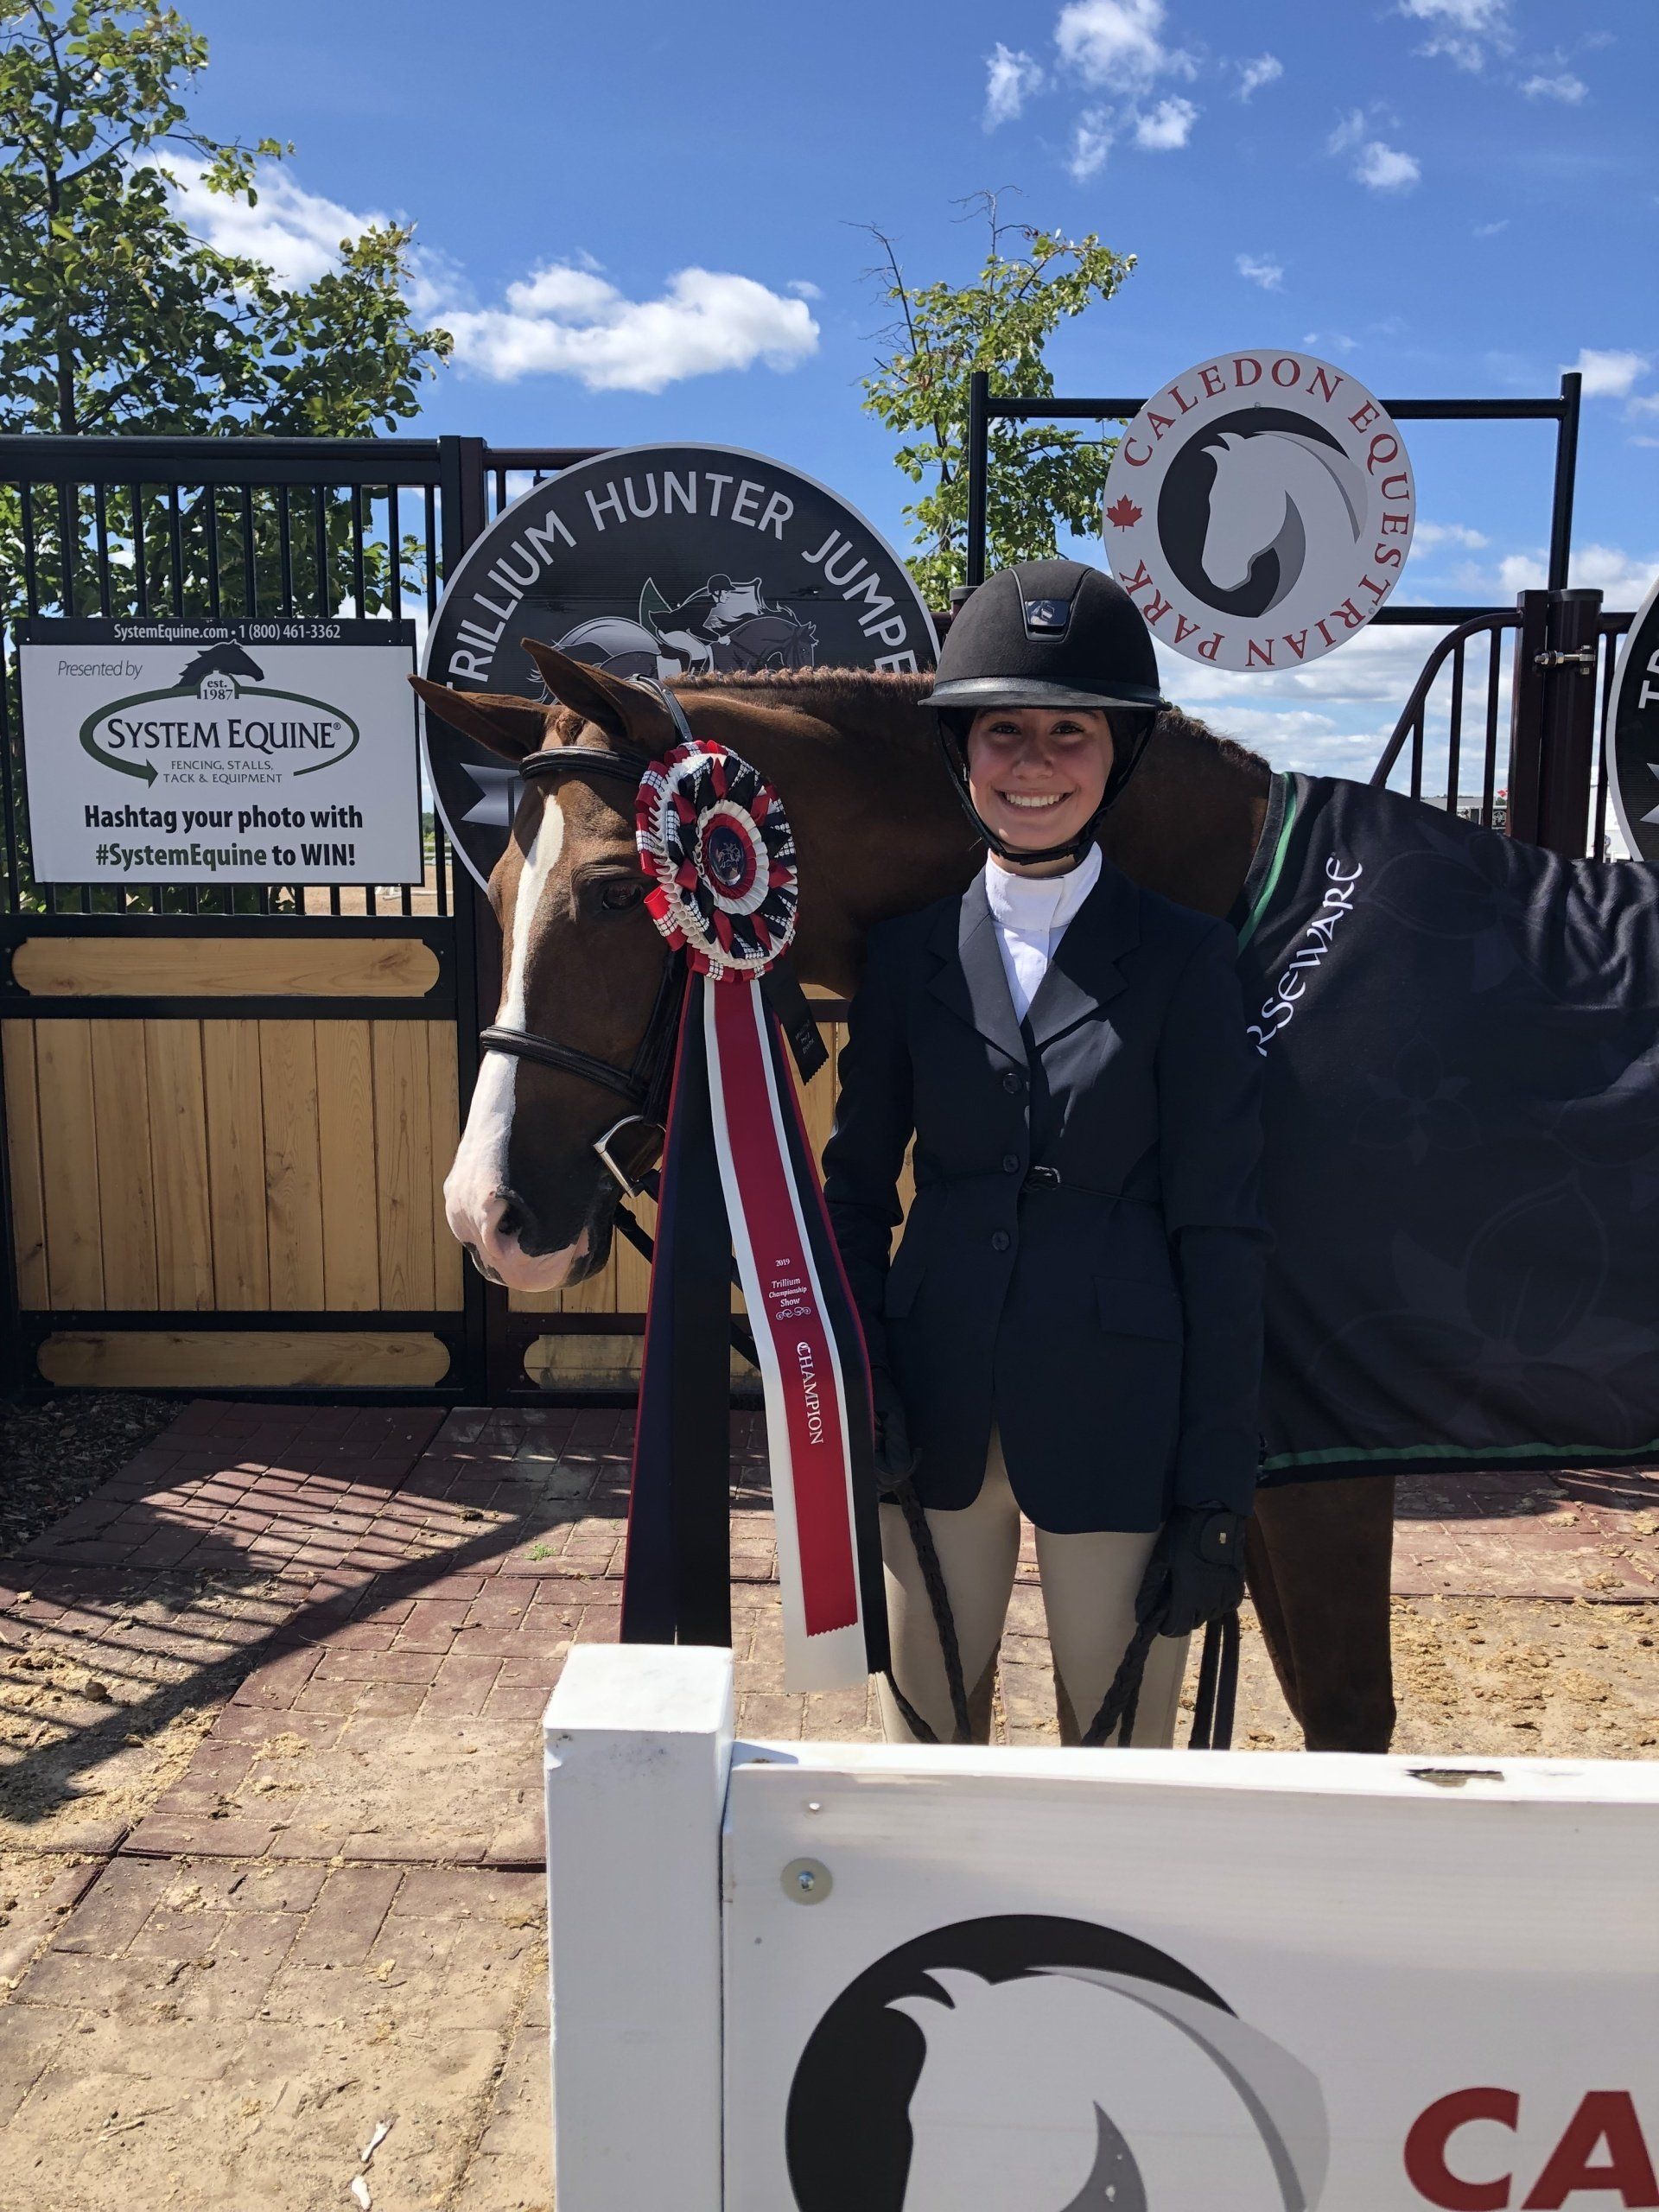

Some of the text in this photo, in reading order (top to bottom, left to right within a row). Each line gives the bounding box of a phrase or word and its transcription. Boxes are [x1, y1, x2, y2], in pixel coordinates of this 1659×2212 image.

[1119, 358, 1410, 667] CALEDON EQUESTRIAN PARK
[446, 511, 577, 690] RILLIUM
[585, 471, 794, 540] HUNTER
[114, 623, 340, 641] SystemEquine.com 1 (800) 461-3362
[58, 661, 143, 679] Presented by
[207, 678, 227, 688] est.
[202, 689, 233, 700] 1987
[107, 719, 220, 748] SYSTEM
[171, 760, 273, 771] FENCING, STALLS,
[163, 773, 283, 784] TACK & EQUIPMENT
[85, 804, 363, 834] Hashtag your photo with
[95, 842, 355, 872] #SystemEquine to WIN!
[775, 1258, 790, 1267] 2019
[772, 1277, 801, 1289] Trillium
[769, 1286, 807, 1299] Championship
[780, 1297, 800, 1307] Show
[797, 1341, 823, 1445] CHAMPION
[1404, 2087, 1659, 2212] CA
